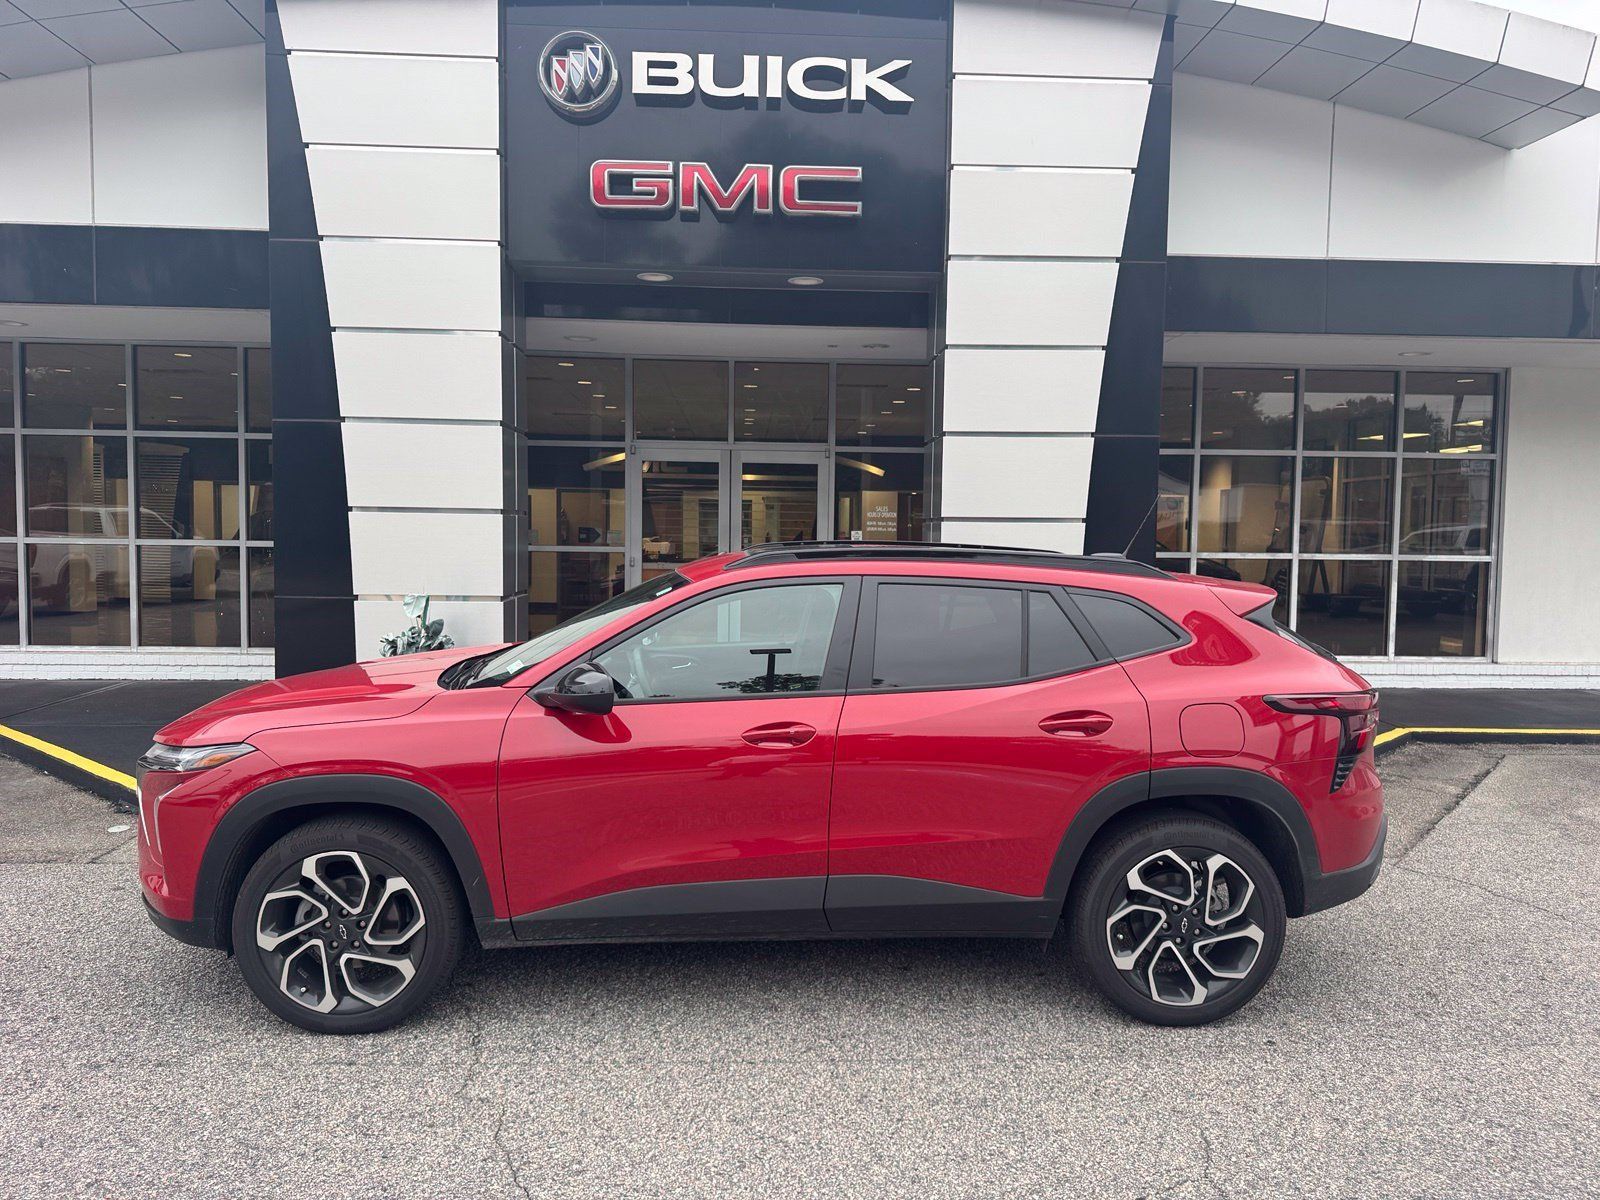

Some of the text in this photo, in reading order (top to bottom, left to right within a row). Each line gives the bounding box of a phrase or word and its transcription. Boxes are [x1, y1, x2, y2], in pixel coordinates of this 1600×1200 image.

[631, 51, 915, 103] BUICK
[589, 159, 863, 217] GMC
[290, 834, 338, 854] Continental
